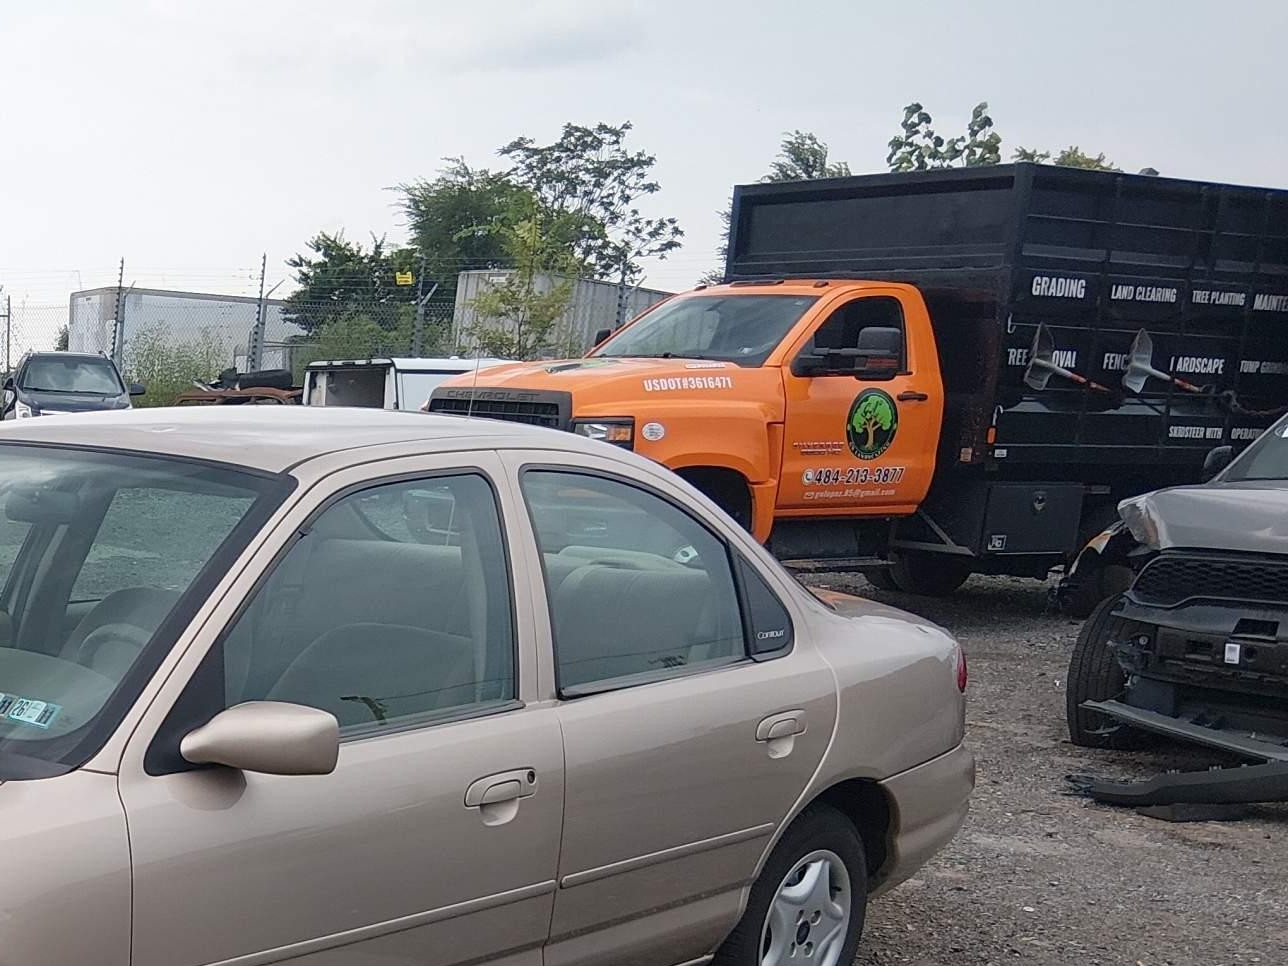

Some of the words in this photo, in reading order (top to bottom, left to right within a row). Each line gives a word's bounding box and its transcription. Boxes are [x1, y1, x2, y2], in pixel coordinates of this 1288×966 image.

[1032, 276, 1086, 299] GRADING
[1111, 284, 1133, 300] LAND
[1135, 287, 1177, 303] CLEARING
[1192, 290, 1209, 304] TREE
[1210, 291, 1245, 306] PLANTING
[1239, 360, 1260, 373] TUMP
[643, 376, 733, 392] USDOT#3616471
[447, 390, 541, 401] CHEVROLET
[1169, 426, 1205, 439] SKIDSTEER
[1205, 427, 1223, 439] WITH
[814, 467, 905, 485] 484-213-3877
[11, 700, 30, 717] 26
